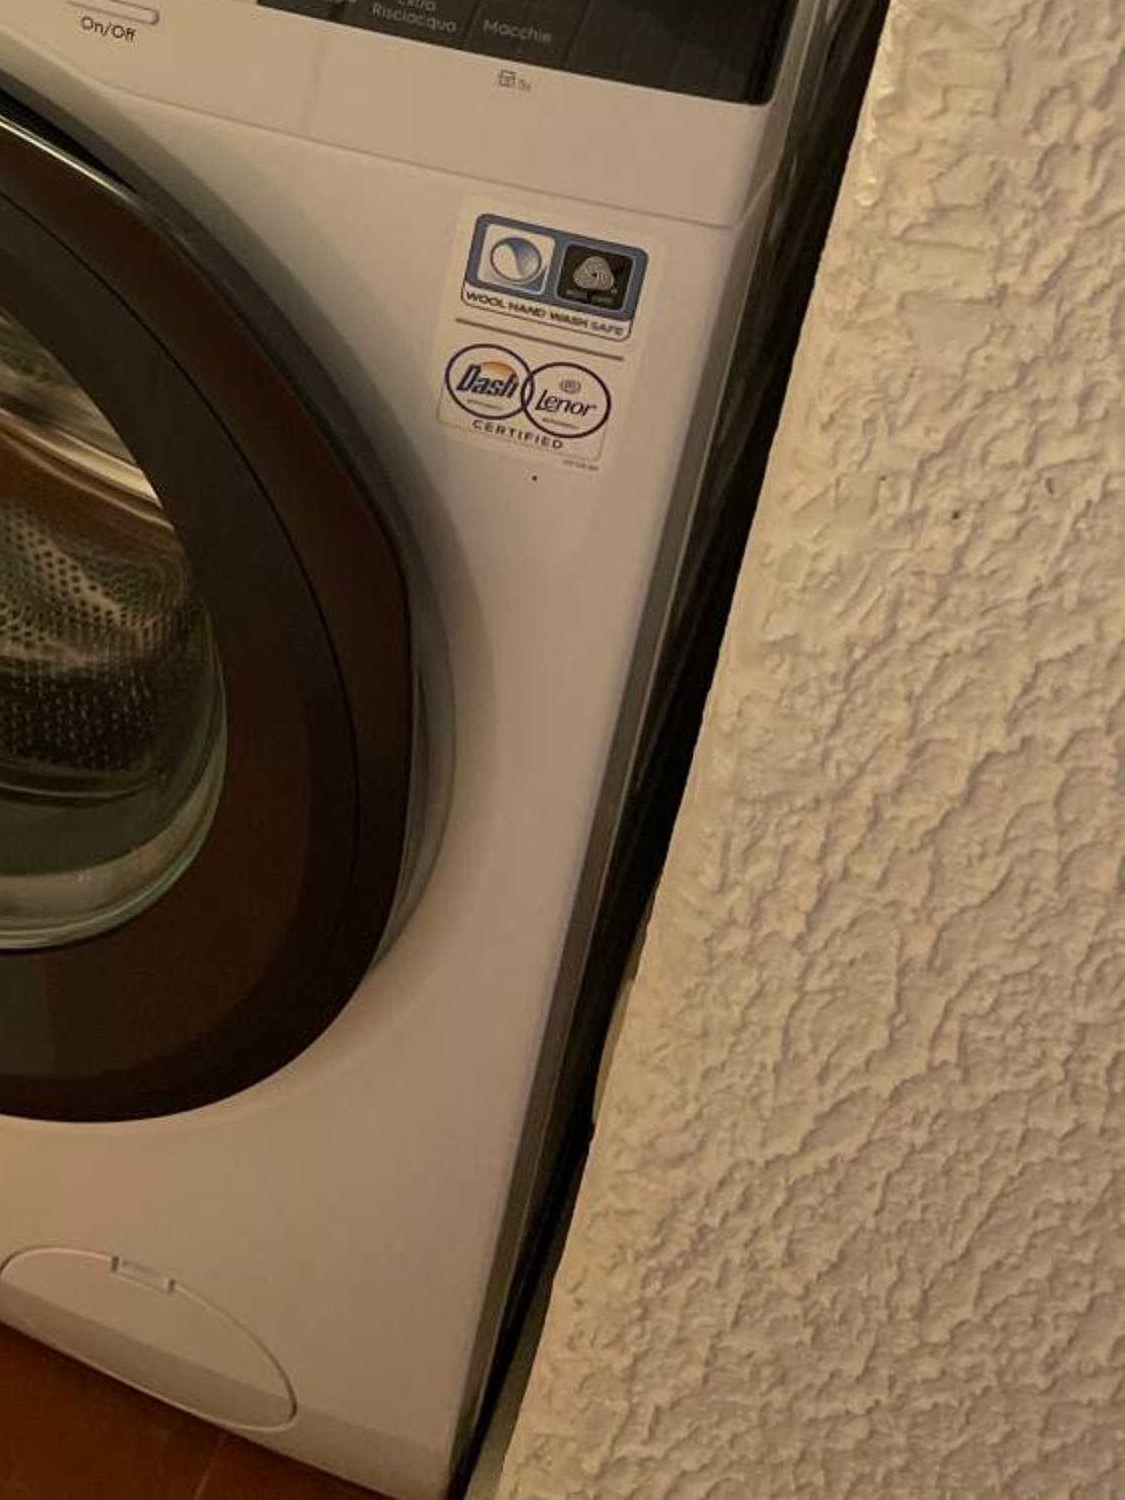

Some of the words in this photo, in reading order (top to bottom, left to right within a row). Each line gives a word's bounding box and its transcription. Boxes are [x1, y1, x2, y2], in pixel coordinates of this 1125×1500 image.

[81, 15, 136, 42] On/Off
[371, 2, 457, 33] Risciacquo
[482, 18, 553, 45] Macchie
[466, 290, 508, 310] WOOL
[507, 301, 547, 319] HAND
[549, 311, 588, 330] WASH
[590, 321, 625, 337] SAFE
[456, 363, 520, 399] Dash
[534, 388, 598, 418] Lenor
[472, 419, 564, 450] CERTIFIED
